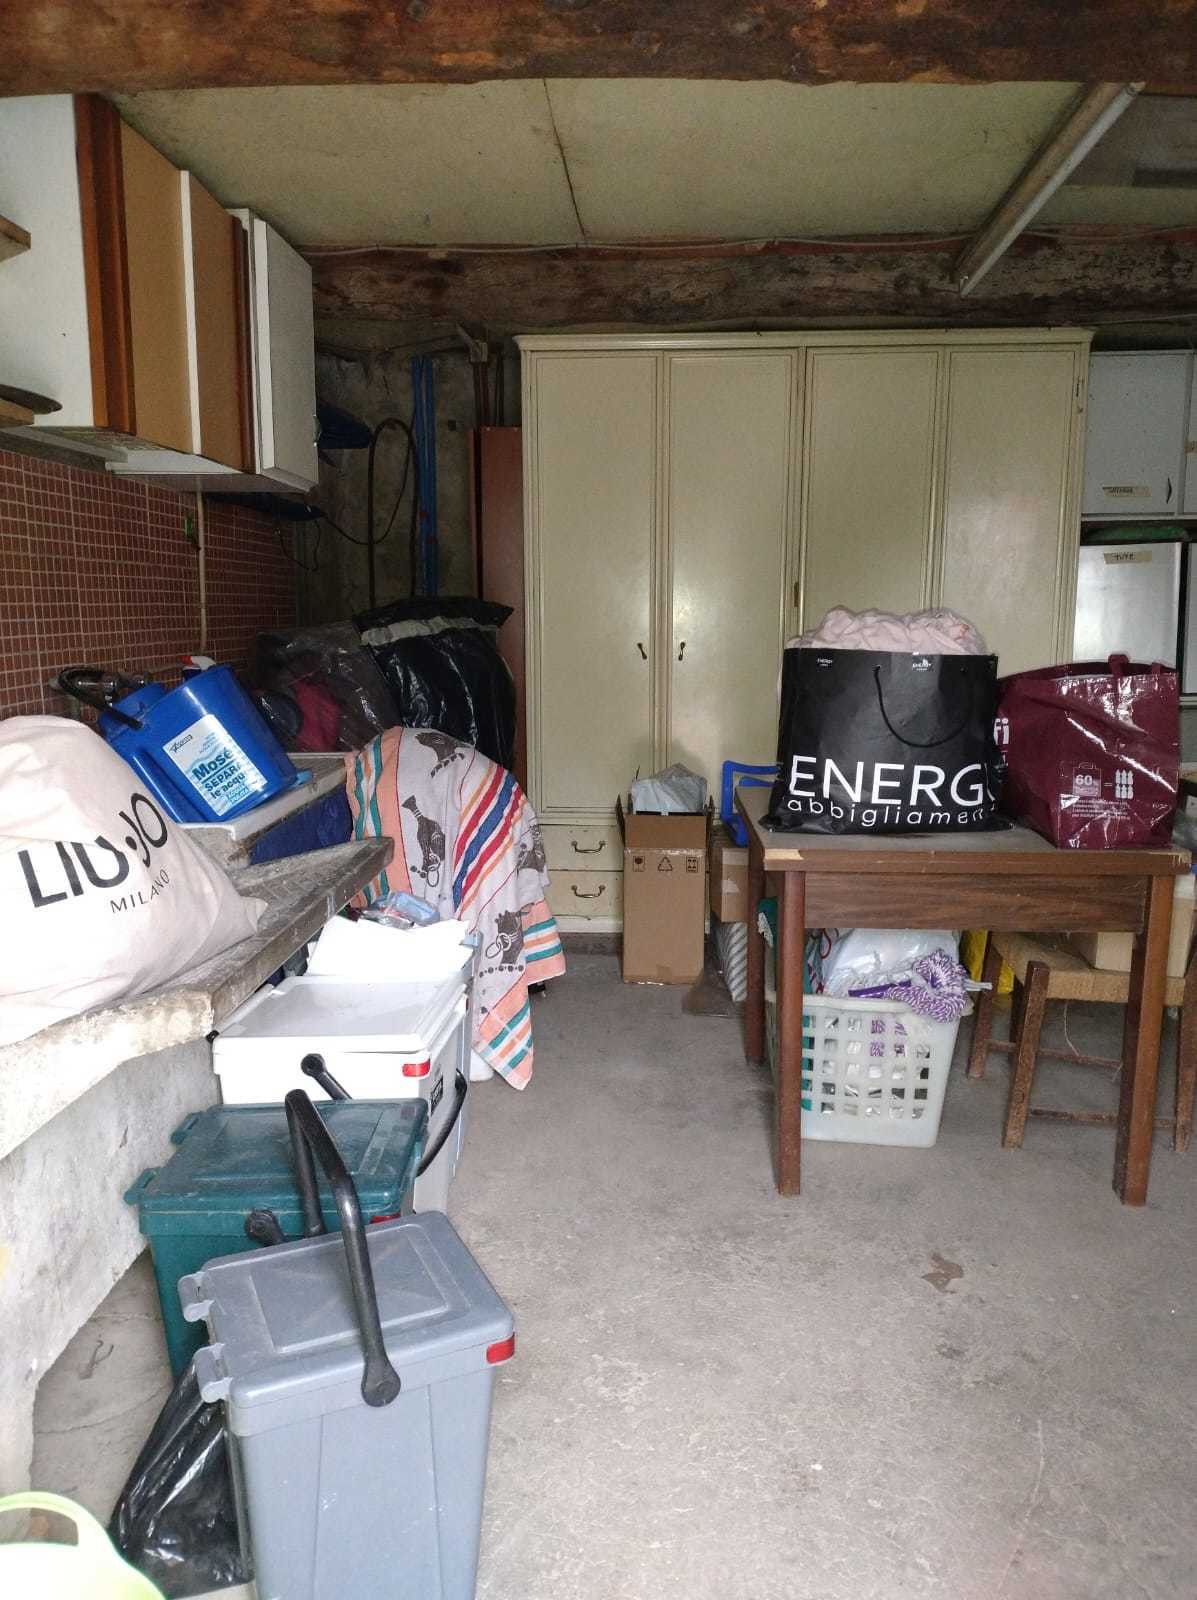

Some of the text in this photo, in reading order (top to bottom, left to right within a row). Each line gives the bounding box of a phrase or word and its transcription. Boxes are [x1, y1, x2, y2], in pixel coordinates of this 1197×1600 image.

[222, 772, 246, 792] acqu
[788, 755, 996, 807] ENERG
[787, 798, 995, 827] abbigliamen
[109, 868, 170, 914] MILANO
